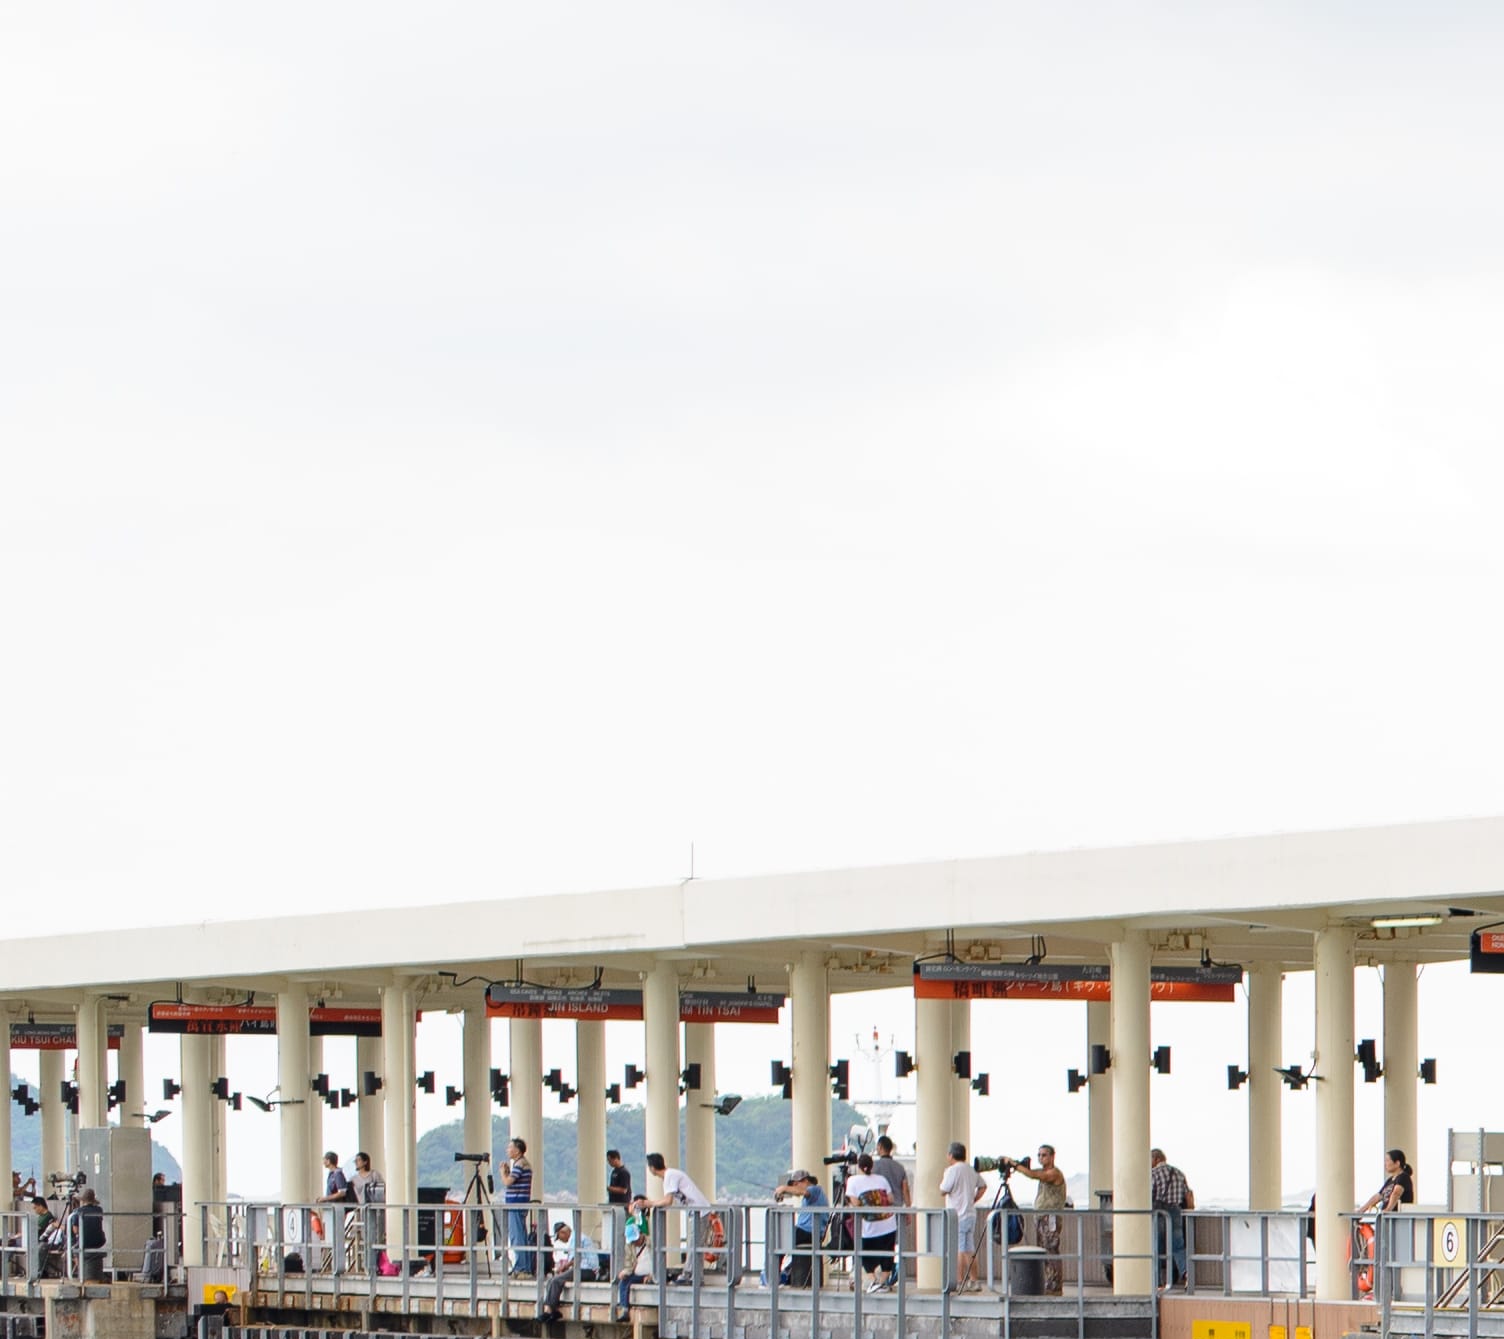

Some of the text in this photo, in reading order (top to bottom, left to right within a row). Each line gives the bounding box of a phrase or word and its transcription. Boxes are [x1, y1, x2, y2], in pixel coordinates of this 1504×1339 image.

[548, 1003, 608, 1013] JIN ISLAND
[717, 1007, 741, 1016] TSAI
[30, 1036, 51, 1044] TSUI
[289, 1217, 296, 1229] 4
[1446, 1231, 1454, 1253] 6
